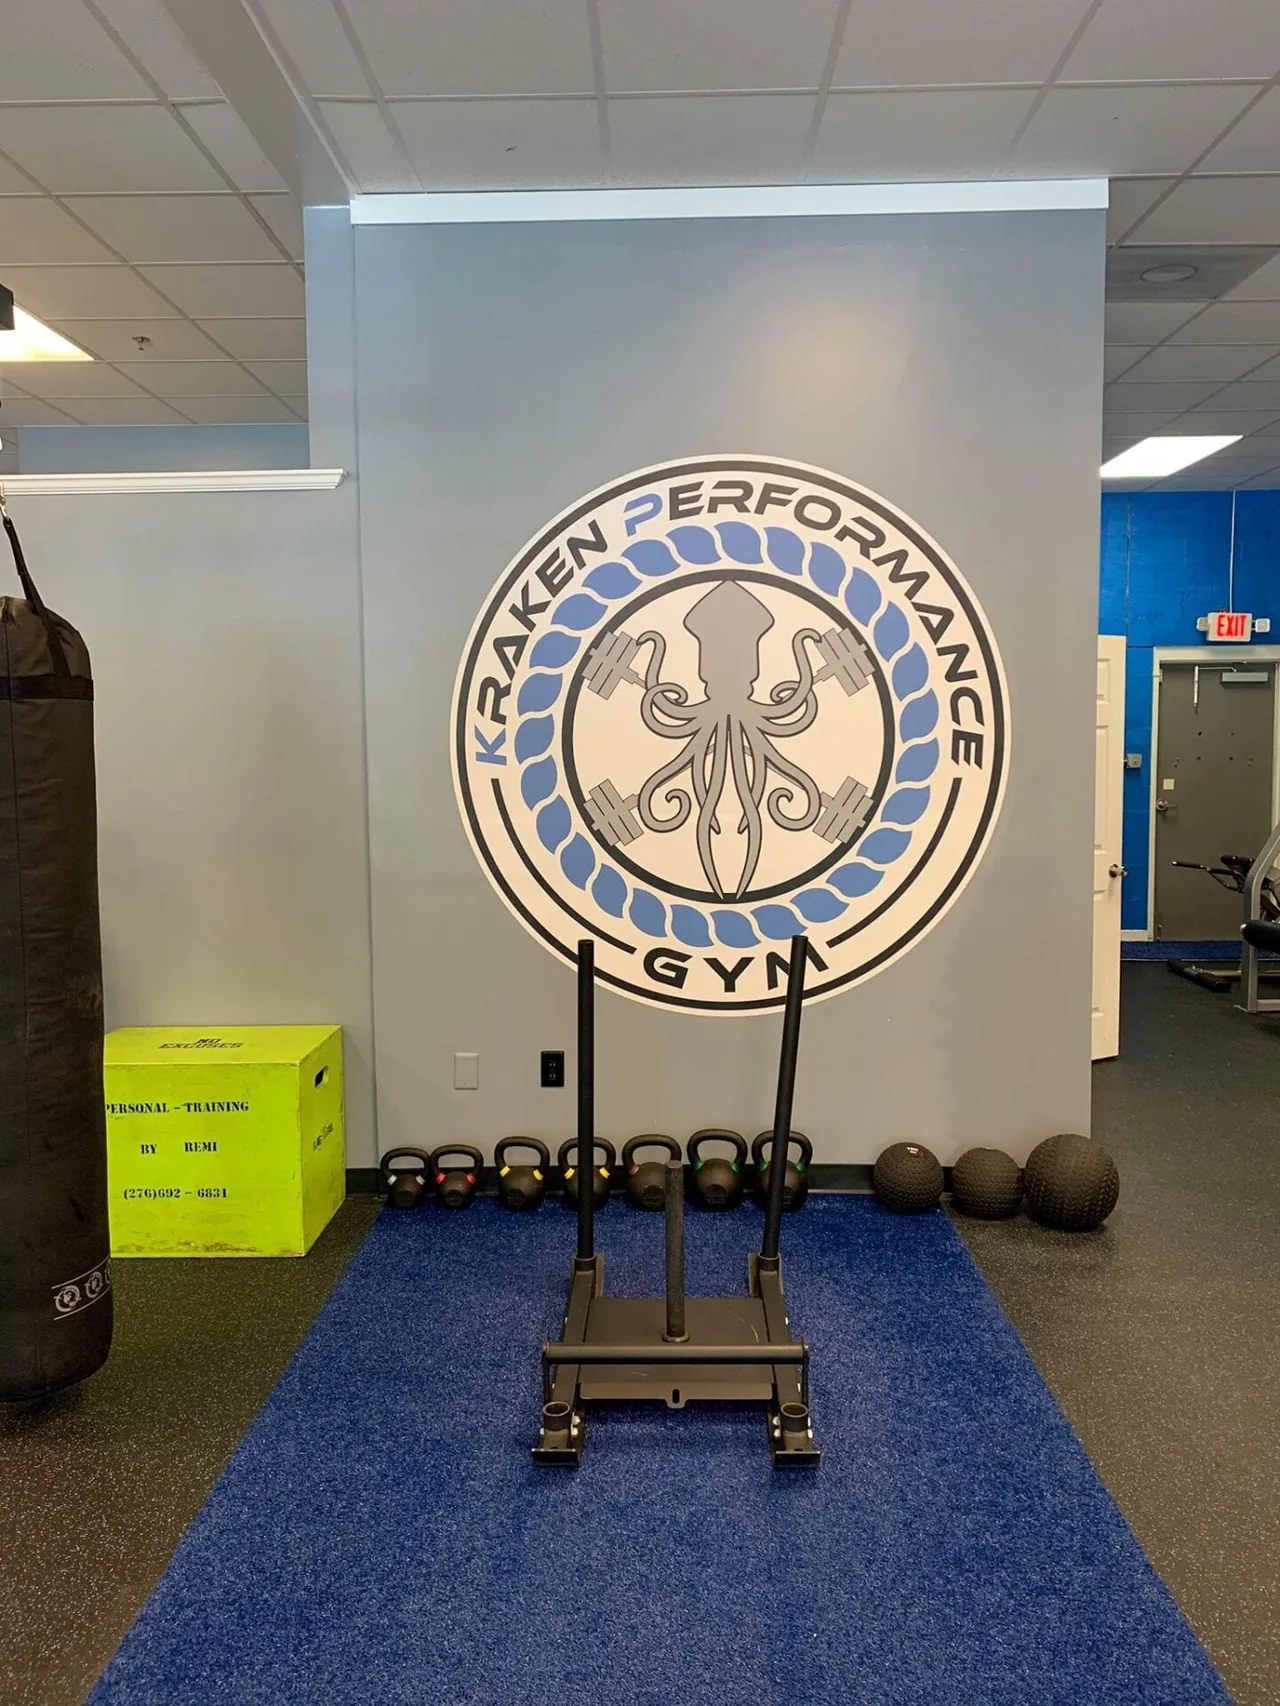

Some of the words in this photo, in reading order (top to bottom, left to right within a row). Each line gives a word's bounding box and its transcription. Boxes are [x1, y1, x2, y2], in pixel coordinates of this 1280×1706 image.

[474, 520, 608, 766] KRAKEN
[623, 480, 985, 769] PERFORMANCE
[1217, 614, 1247, 637] EXIT
[643, 947, 829, 993] GYM
[185, 1101, 249, 1113] TRAINING
[140, 1144, 157, 1154] BY
[184, 1142, 217, 1152] REMI
